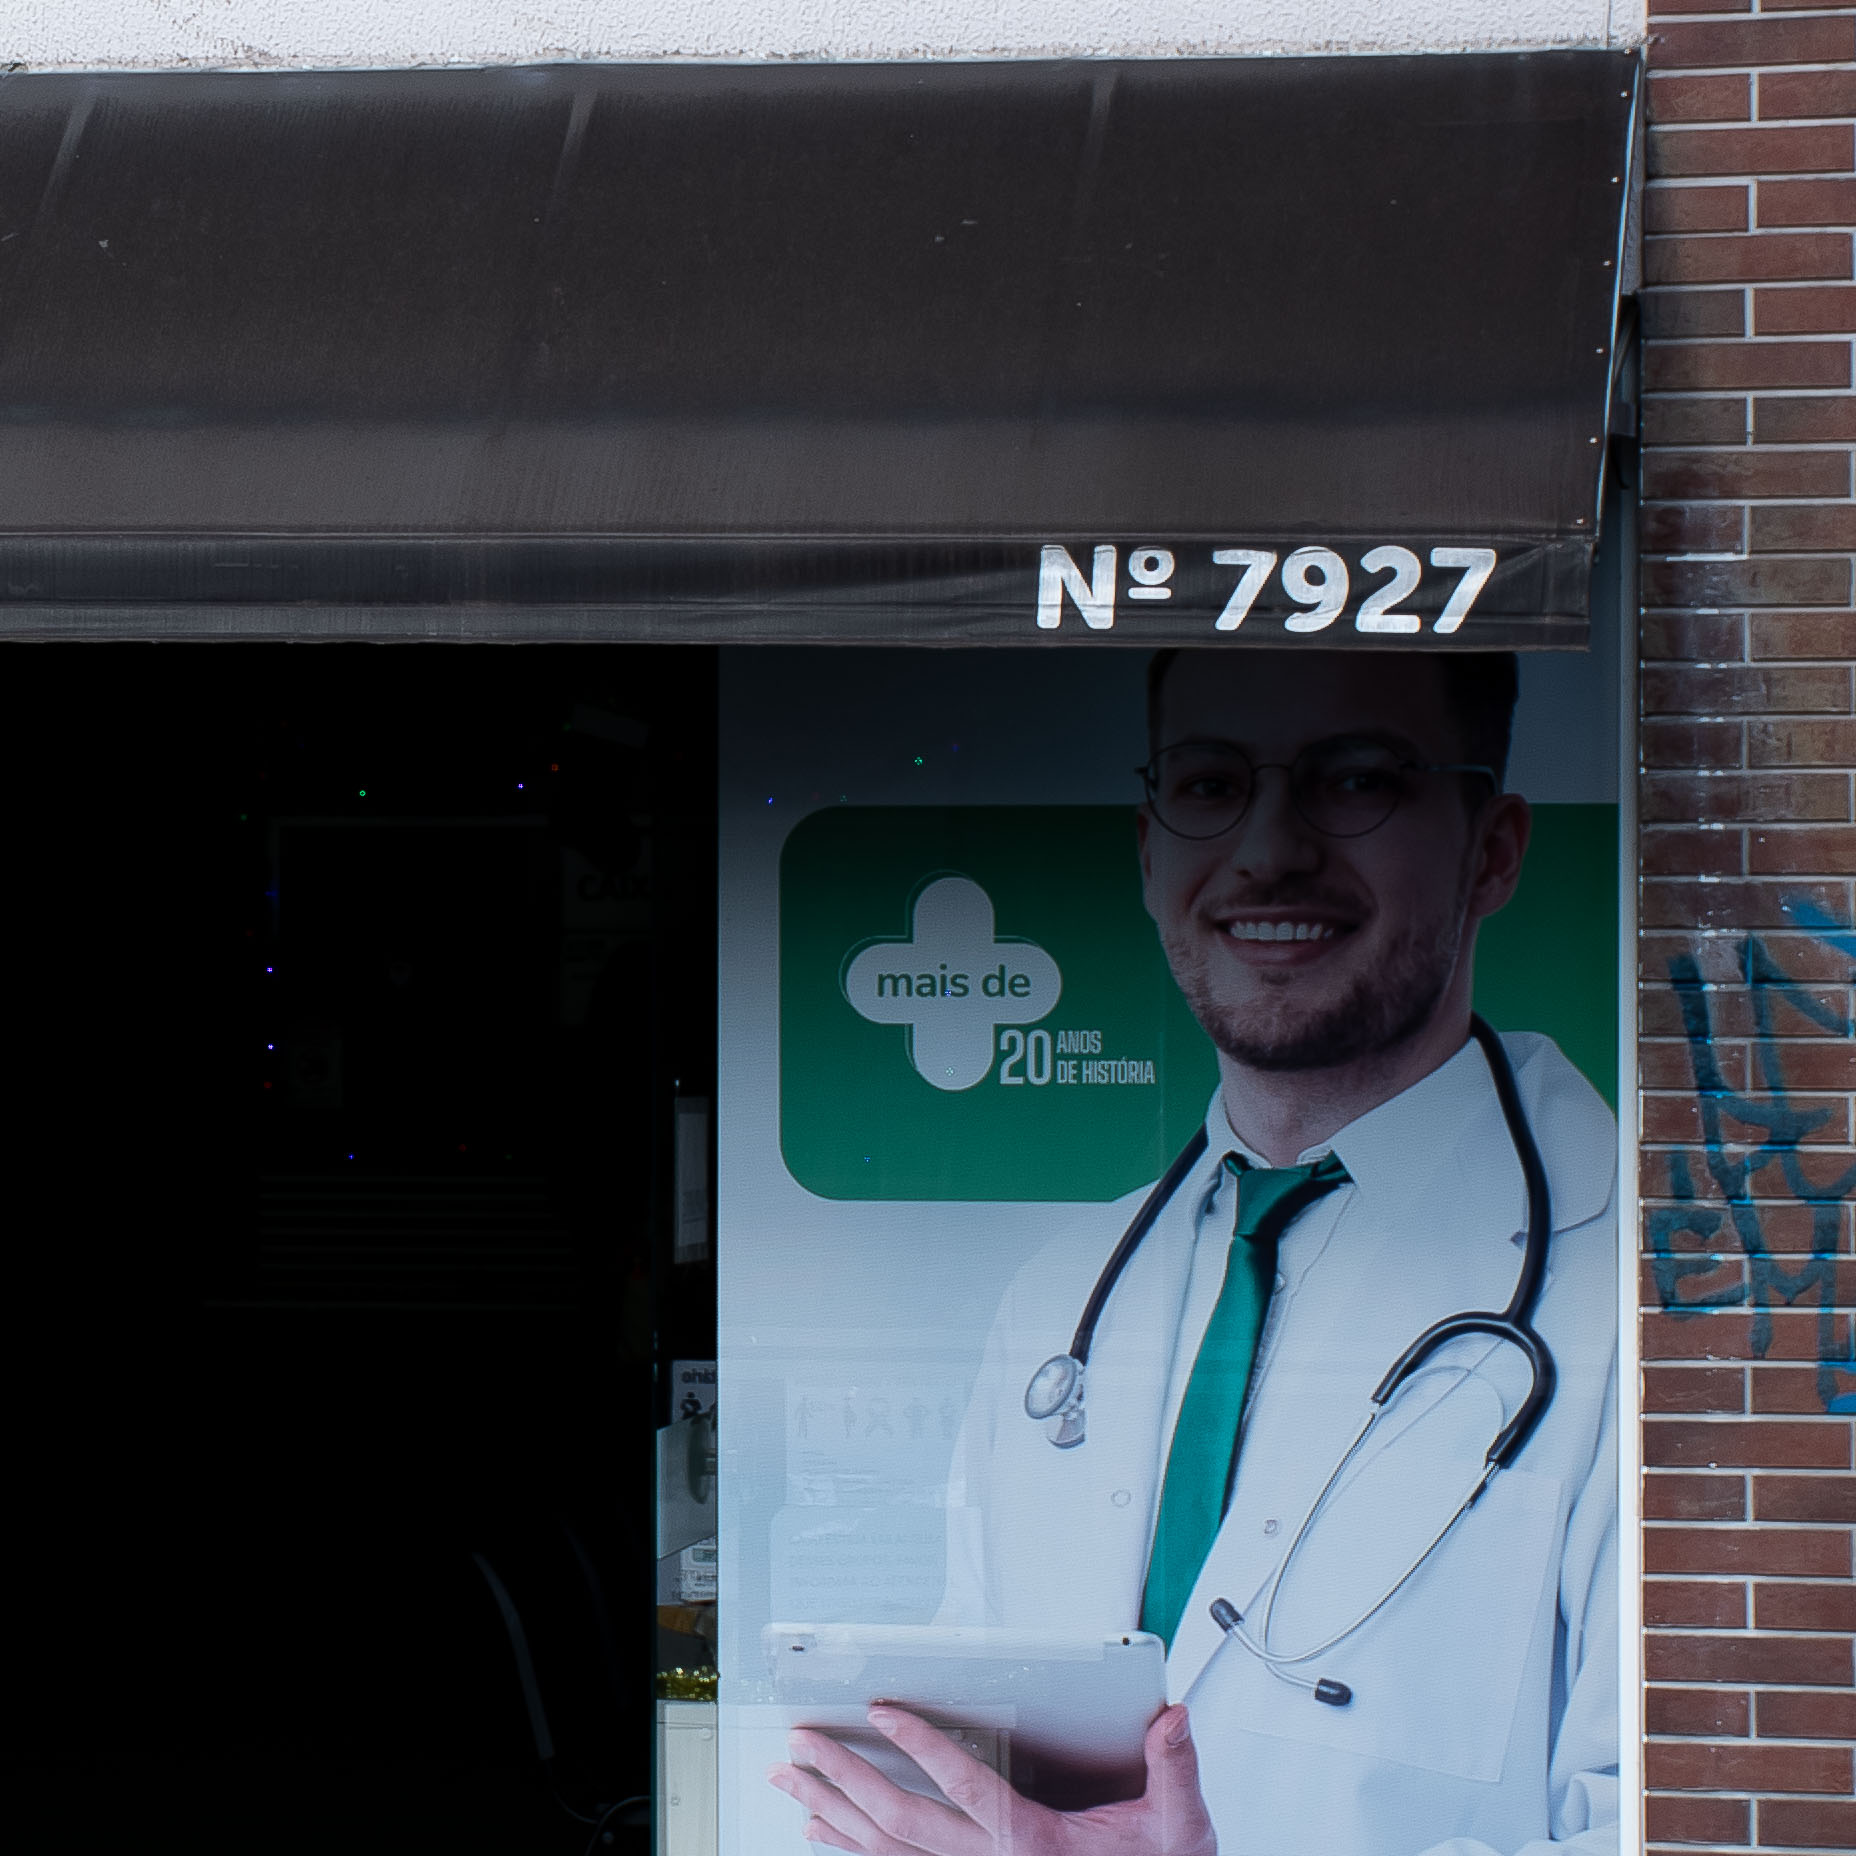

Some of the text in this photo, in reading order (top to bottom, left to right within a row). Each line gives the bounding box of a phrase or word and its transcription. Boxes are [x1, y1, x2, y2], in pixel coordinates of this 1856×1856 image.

[1036, 544, 1498, 634] Nº 7927
[877, 963, 1032, 998] mais de
[999, 1029, 1102, 1085] 20 ANOS
[1056, 1056, 1156, 1084] DE HISTÓRIA
